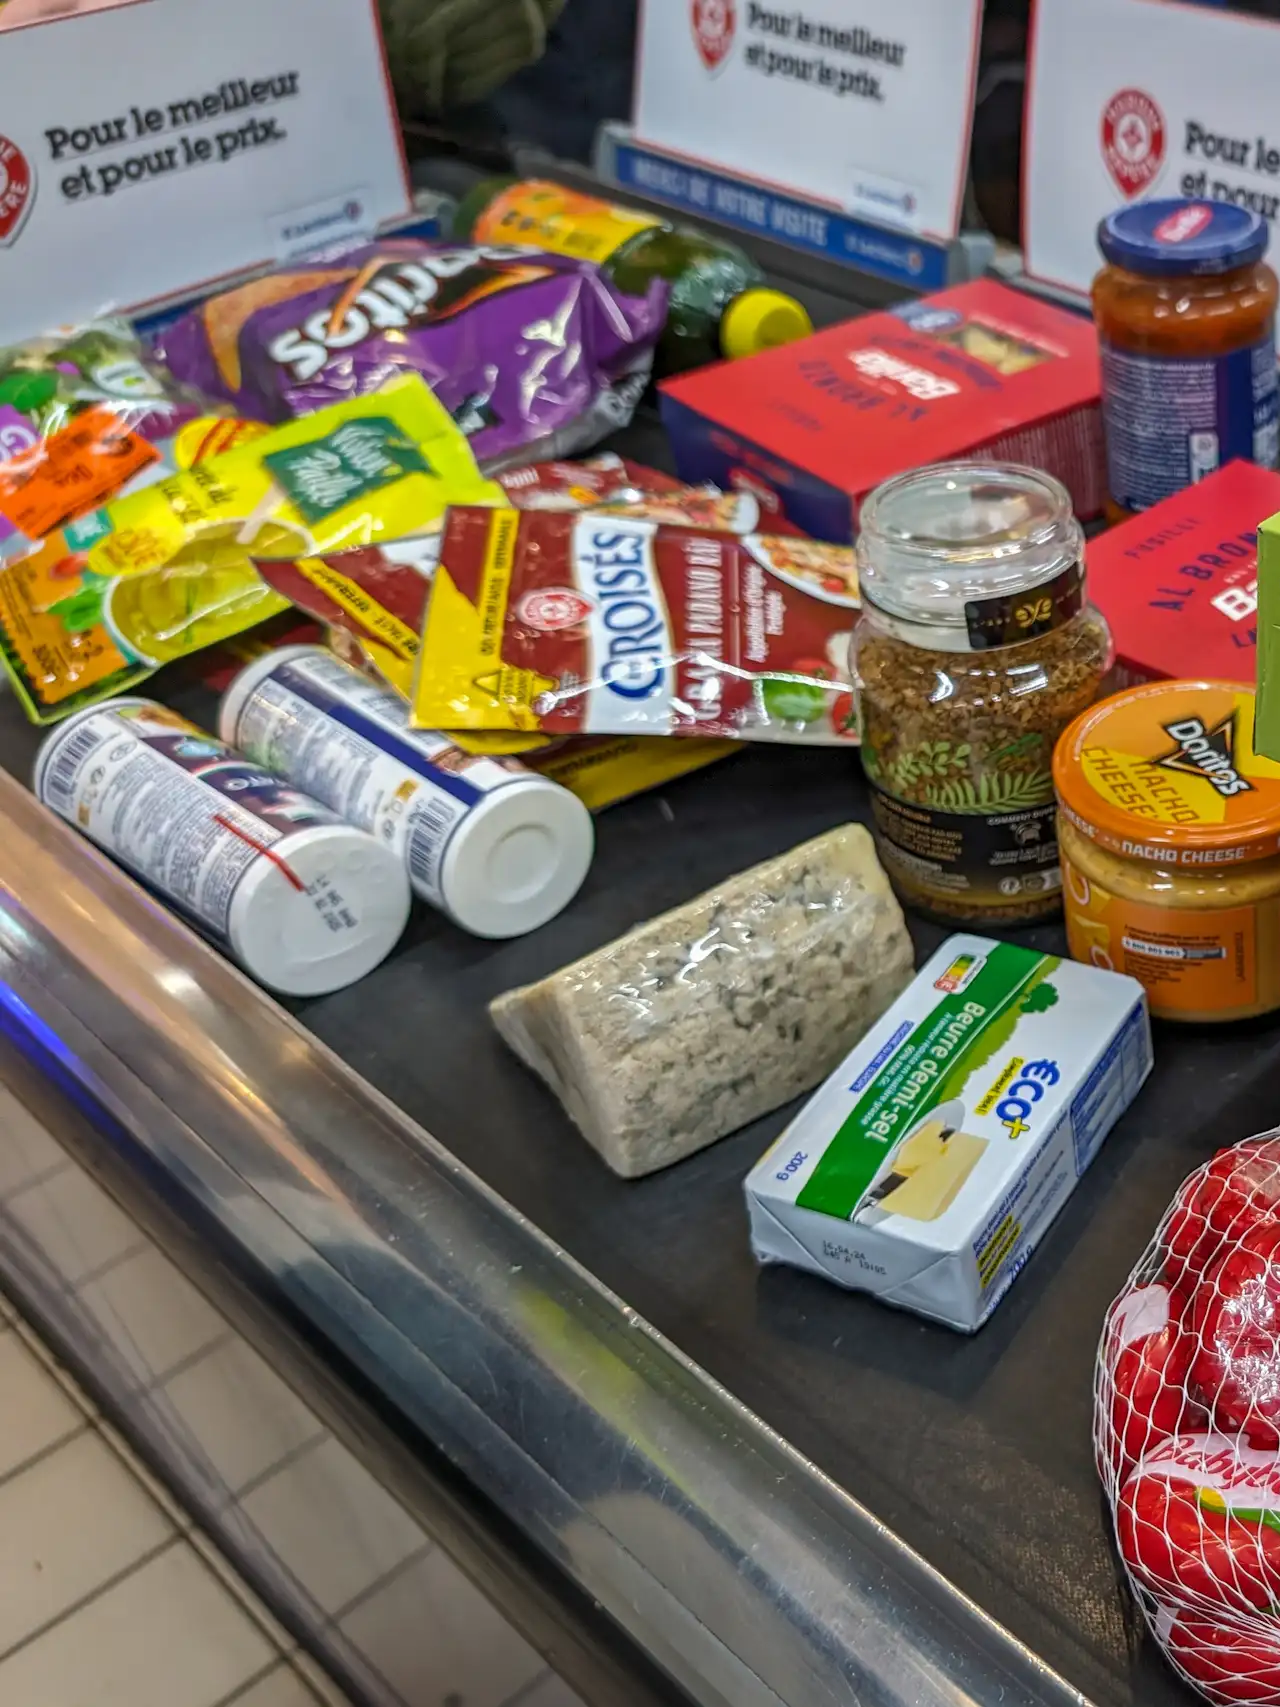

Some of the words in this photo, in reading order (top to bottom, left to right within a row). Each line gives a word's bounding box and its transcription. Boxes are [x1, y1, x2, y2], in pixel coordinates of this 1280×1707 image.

[813, 18, 907, 67] meilleur
[43, 110, 129, 160] Pour
[128, 97, 167, 136] le
[163, 64, 304, 127] meilleur
[1178, 118, 1254, 167] Pour
[56, 162, 96, 200] et
[95, 145, 183, 196] pour
[178, 130, 215, 165] le
[211, 110, 290, 163] prix.
[1177, 164, 1210, 200] et
[685, 566, 724, 634] PADANO
[1149, 577, 1195, 611] AL
[1168, 719, 1251, 797] Doritos
[1133, 760, 1199, 824] NACHO
[1120, 839, 1179, 863] NACHO
[928, 996, 987, 1065] Beurre
[862, 1054, 943, 1149] demi-sel
[785, 1151, 808, 1175] 200
